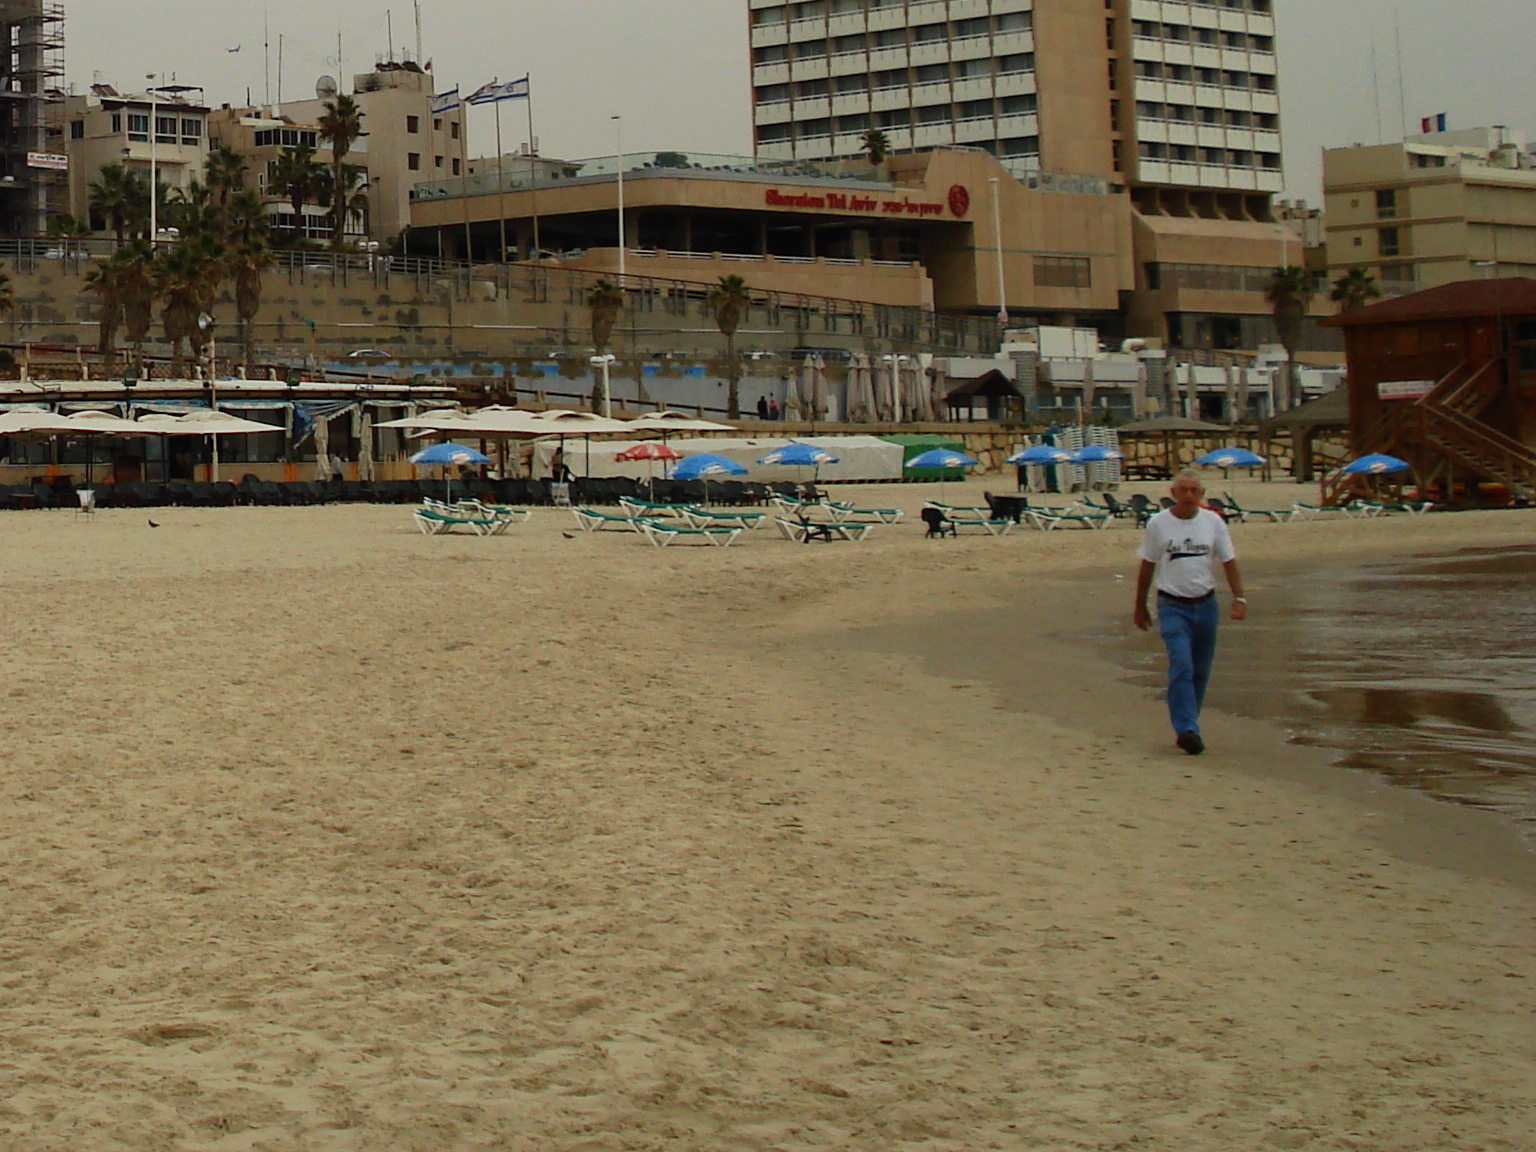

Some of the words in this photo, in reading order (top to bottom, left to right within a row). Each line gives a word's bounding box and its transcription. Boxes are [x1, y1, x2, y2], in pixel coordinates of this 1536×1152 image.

[765, 189, 824, 208] Sheraton
[827, 193, 846, 209] Tel
[850, 195, 878, 211] Aviv
